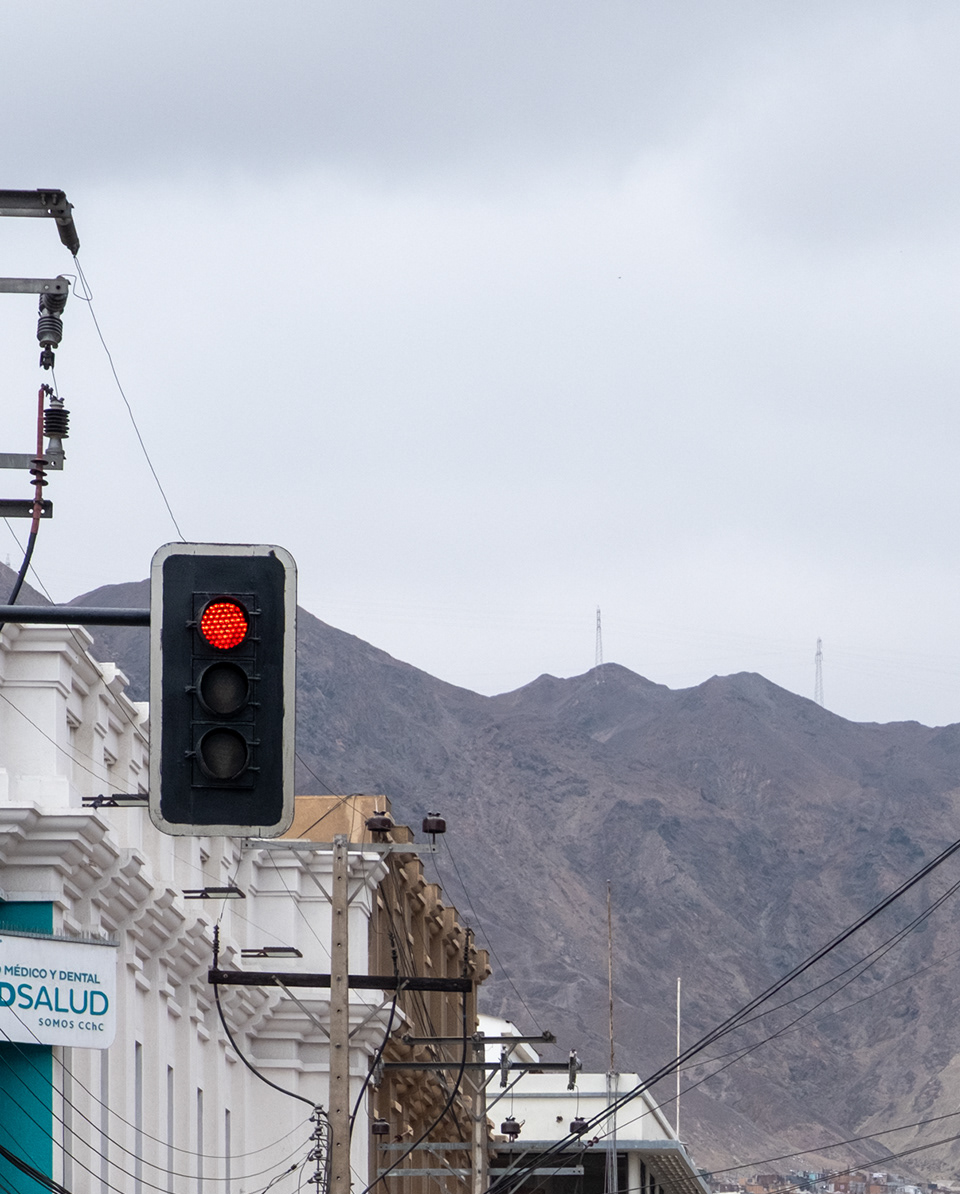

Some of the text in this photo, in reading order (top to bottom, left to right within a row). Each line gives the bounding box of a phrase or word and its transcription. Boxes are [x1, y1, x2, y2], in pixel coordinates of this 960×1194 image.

[4, 964, 101, 984] MÉDICO Y DENTAL
[0, 981, 109, 1016] DSALUD
[38, 1017, 104, 1032] SOMOS CChC
